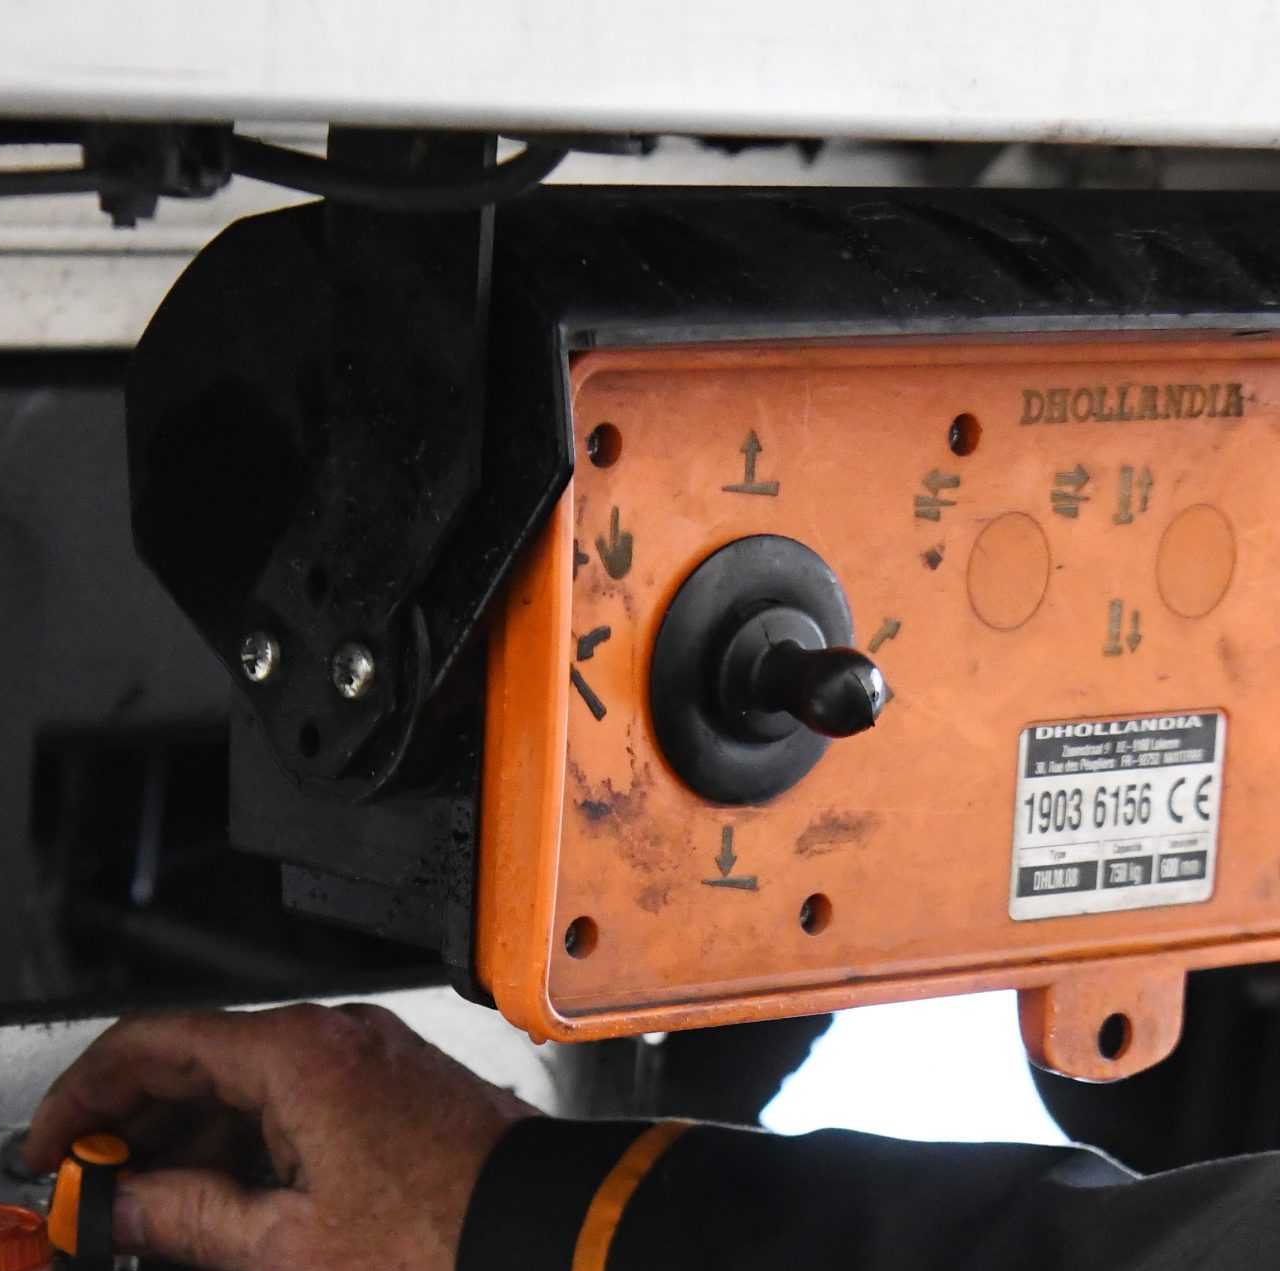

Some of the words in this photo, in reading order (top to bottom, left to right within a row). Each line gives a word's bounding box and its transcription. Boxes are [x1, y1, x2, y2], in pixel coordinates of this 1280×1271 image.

[1020, 383, 1244, 425] DHOLLANDIA
[1035, 716, 1203, 740] DHOLLANDIA
[1024, 788, 1083, 834] 1903
[1093, 782, 1152, 829] 6156
[1167, 775, 1213, 823] CE
